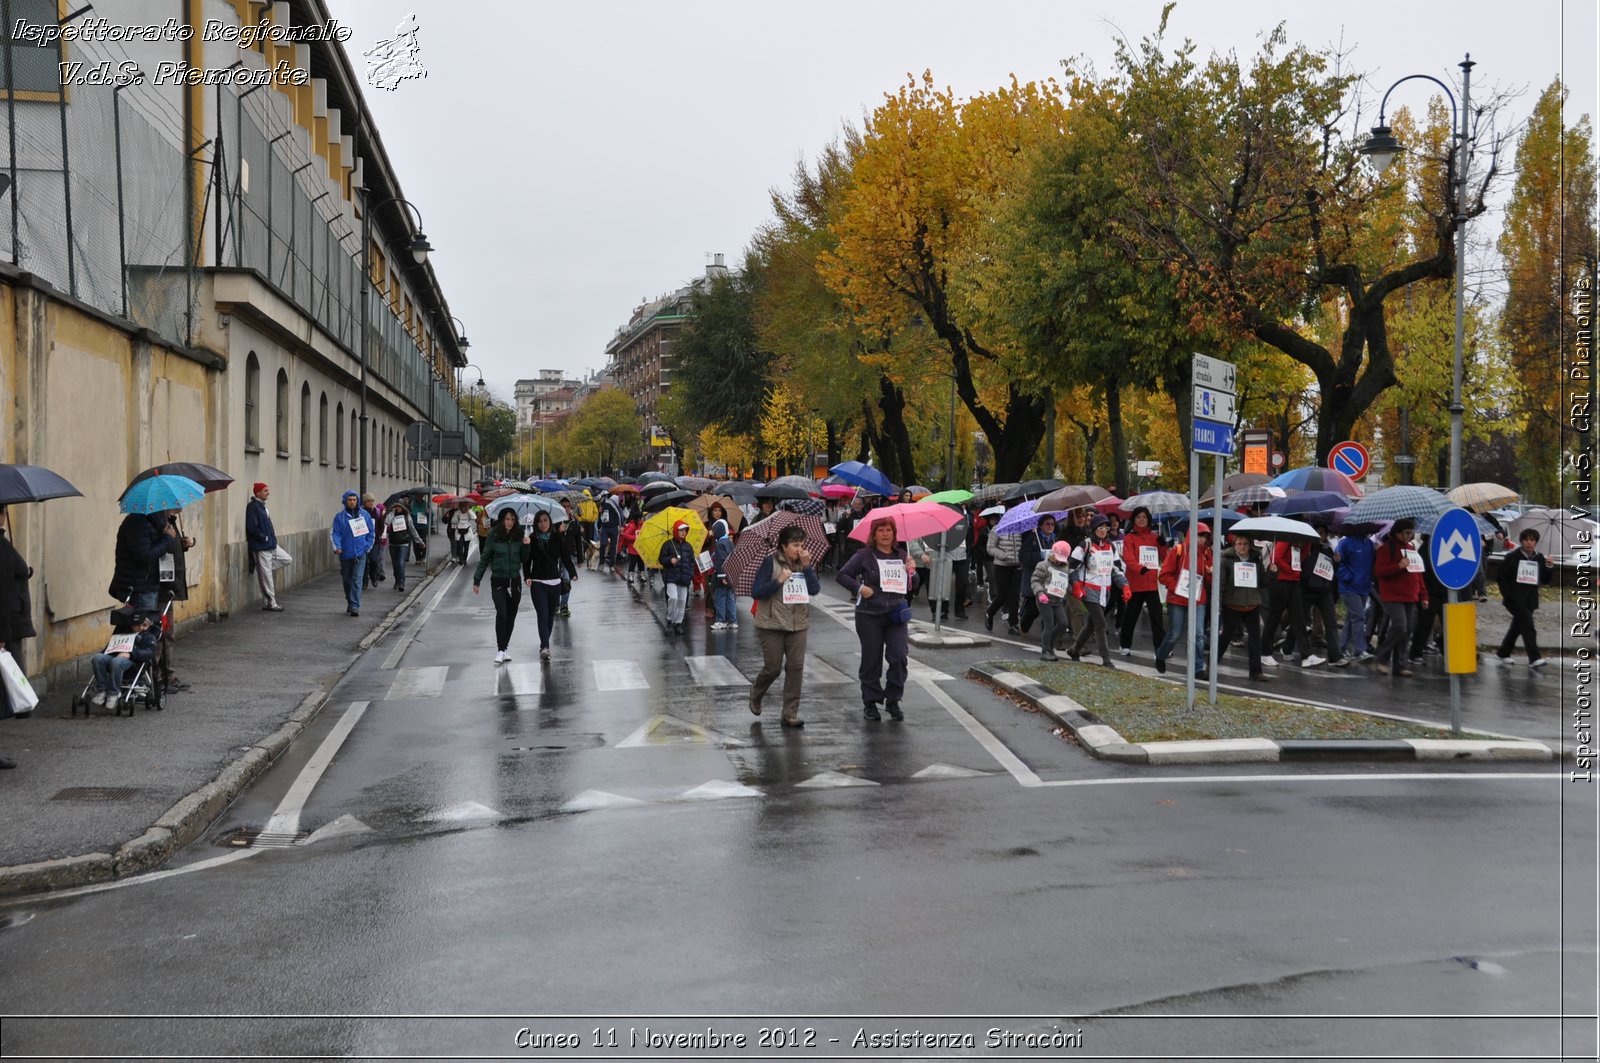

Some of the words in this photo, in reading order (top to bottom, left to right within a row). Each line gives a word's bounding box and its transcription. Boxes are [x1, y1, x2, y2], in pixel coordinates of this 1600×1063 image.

[1196, 358, 1209, 369] polizia
[1196, 371, 1212, 383] stradale
[1194, 427, 1215, 445] FRANCIA
[884, 570, 901, 578] 10392
[1242, 571, 1249, 579] 50
